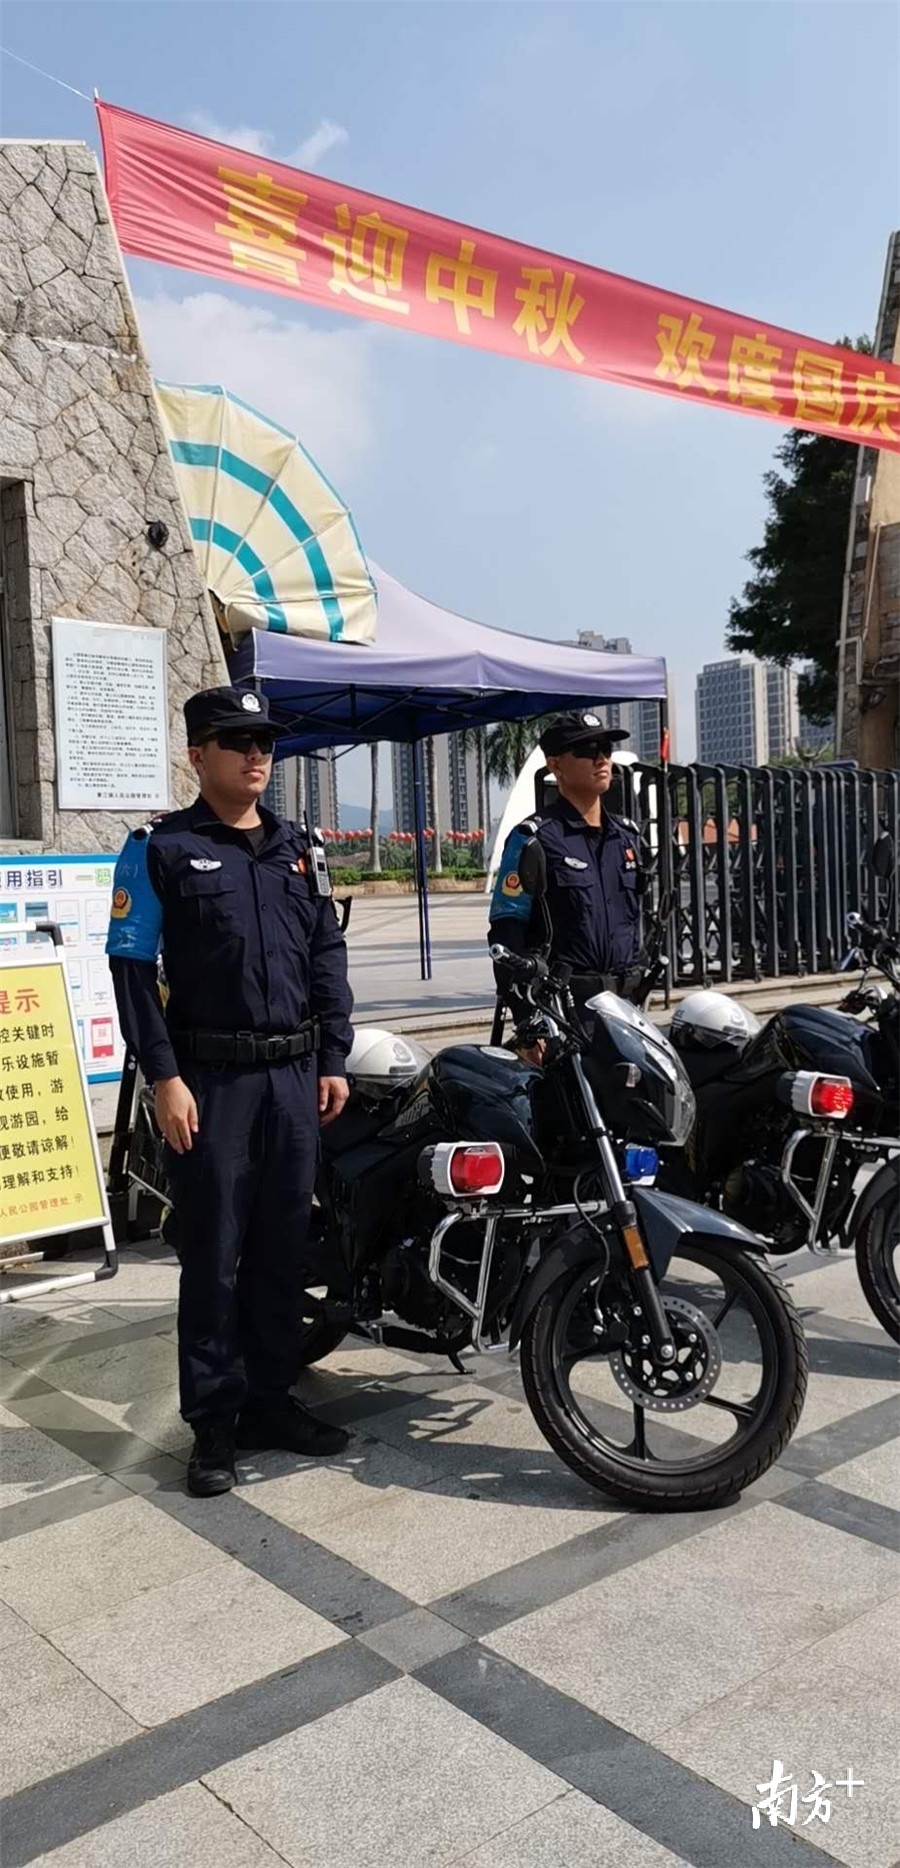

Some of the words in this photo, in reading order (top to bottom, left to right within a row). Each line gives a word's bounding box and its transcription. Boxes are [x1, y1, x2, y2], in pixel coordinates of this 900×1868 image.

[214, 165, 585, 364] 喜迎中秋
[654, 313, 900, 441] 欢度国庆
[0, 868, 63, 888] 用指引
[2, 1050, 59, 1072] 乐设施暂
[0, 1078, 64, 1101] 使用，游
